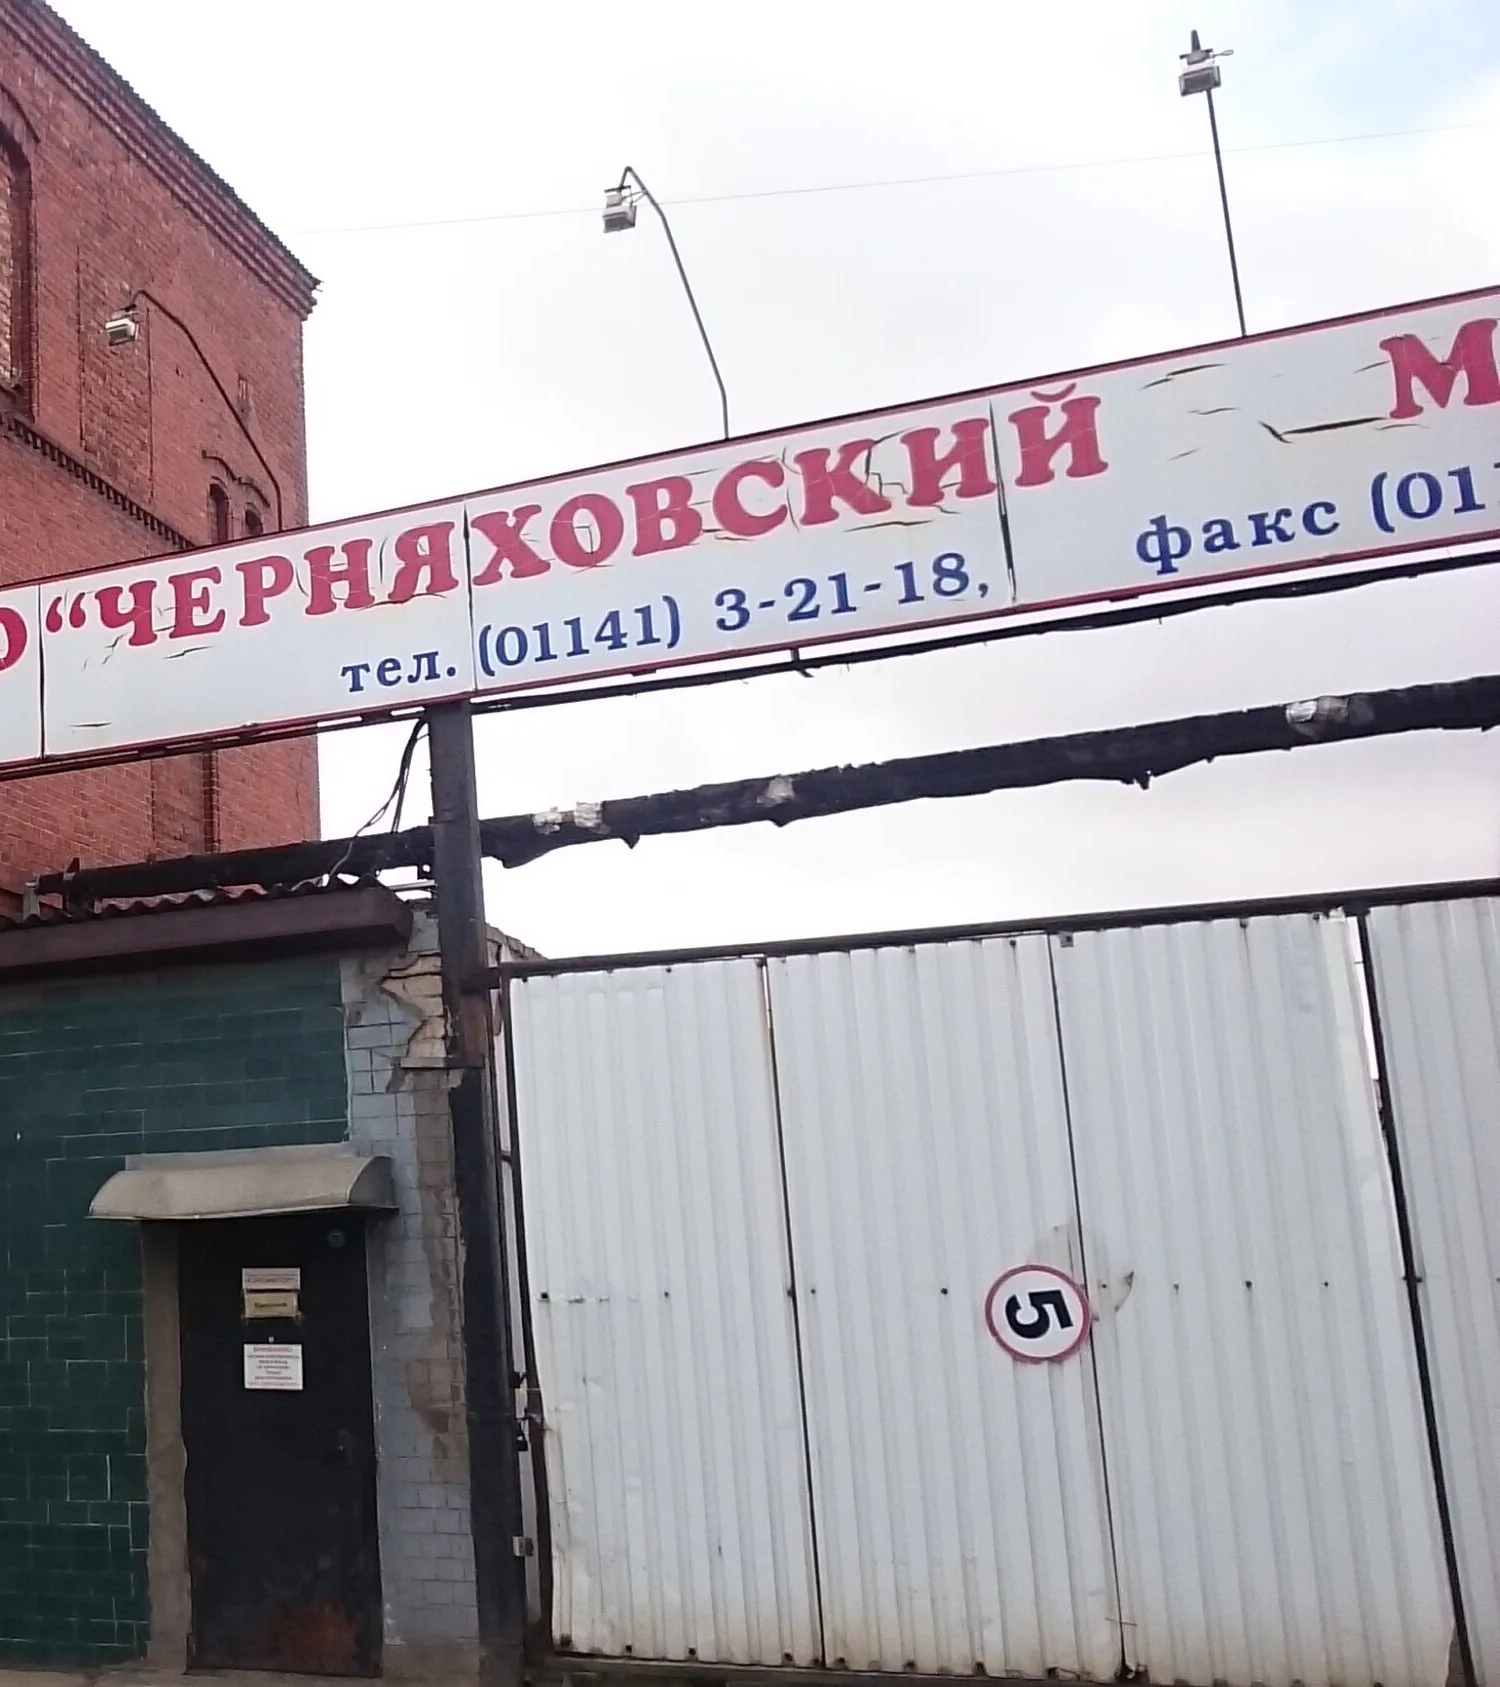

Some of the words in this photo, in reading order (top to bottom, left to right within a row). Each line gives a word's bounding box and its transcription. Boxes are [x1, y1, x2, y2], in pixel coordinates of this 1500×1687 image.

[341, 650, 457, 693] тел.
[478, 595, 681, 677] (01141)
[714, 552, 989, 632] 3-21-18,
[1136, 501, 1340, 576] факс
[1370, 462, 1500, 533] (01
[1005, 1289, 1074, 1339] 5
